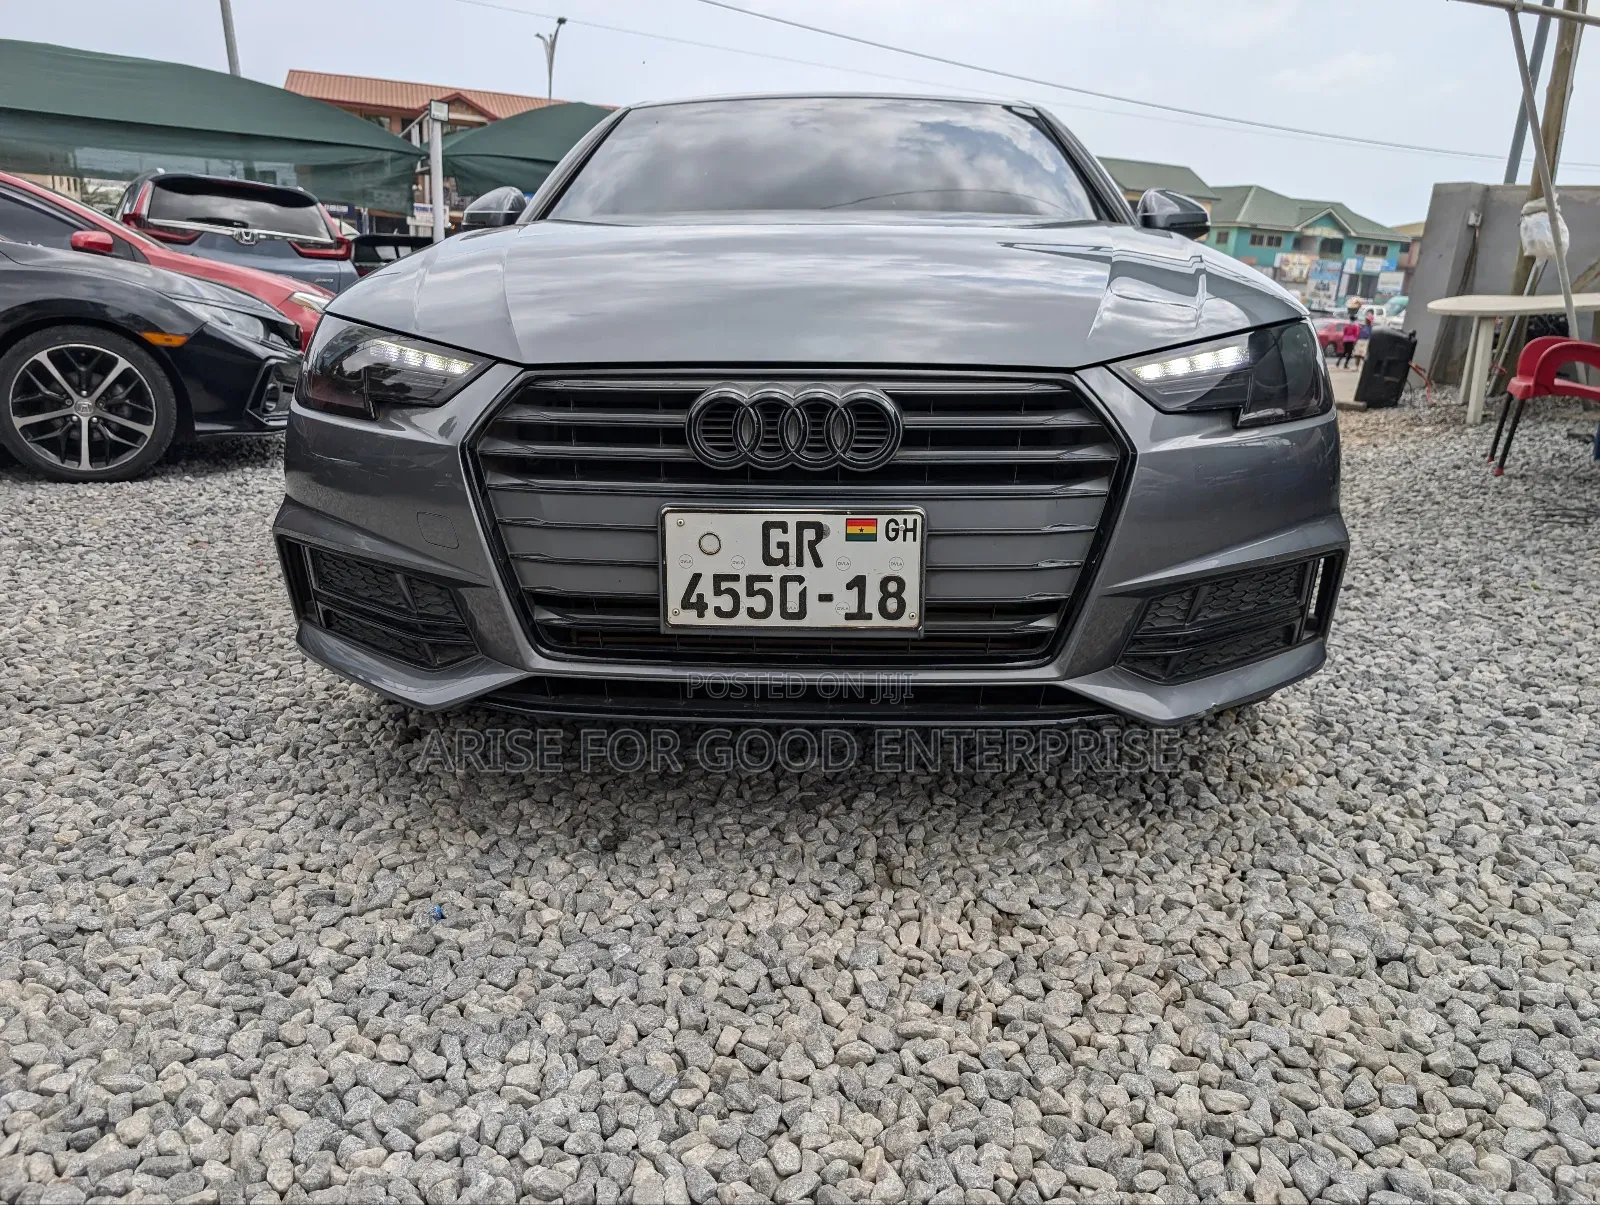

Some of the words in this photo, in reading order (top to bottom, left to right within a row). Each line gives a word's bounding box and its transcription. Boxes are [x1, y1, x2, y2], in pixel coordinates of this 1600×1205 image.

[761, 520, 824, 568] GR
[885, 517, 918, 543] GH
[680, 572, 907, 621] 4550-18
